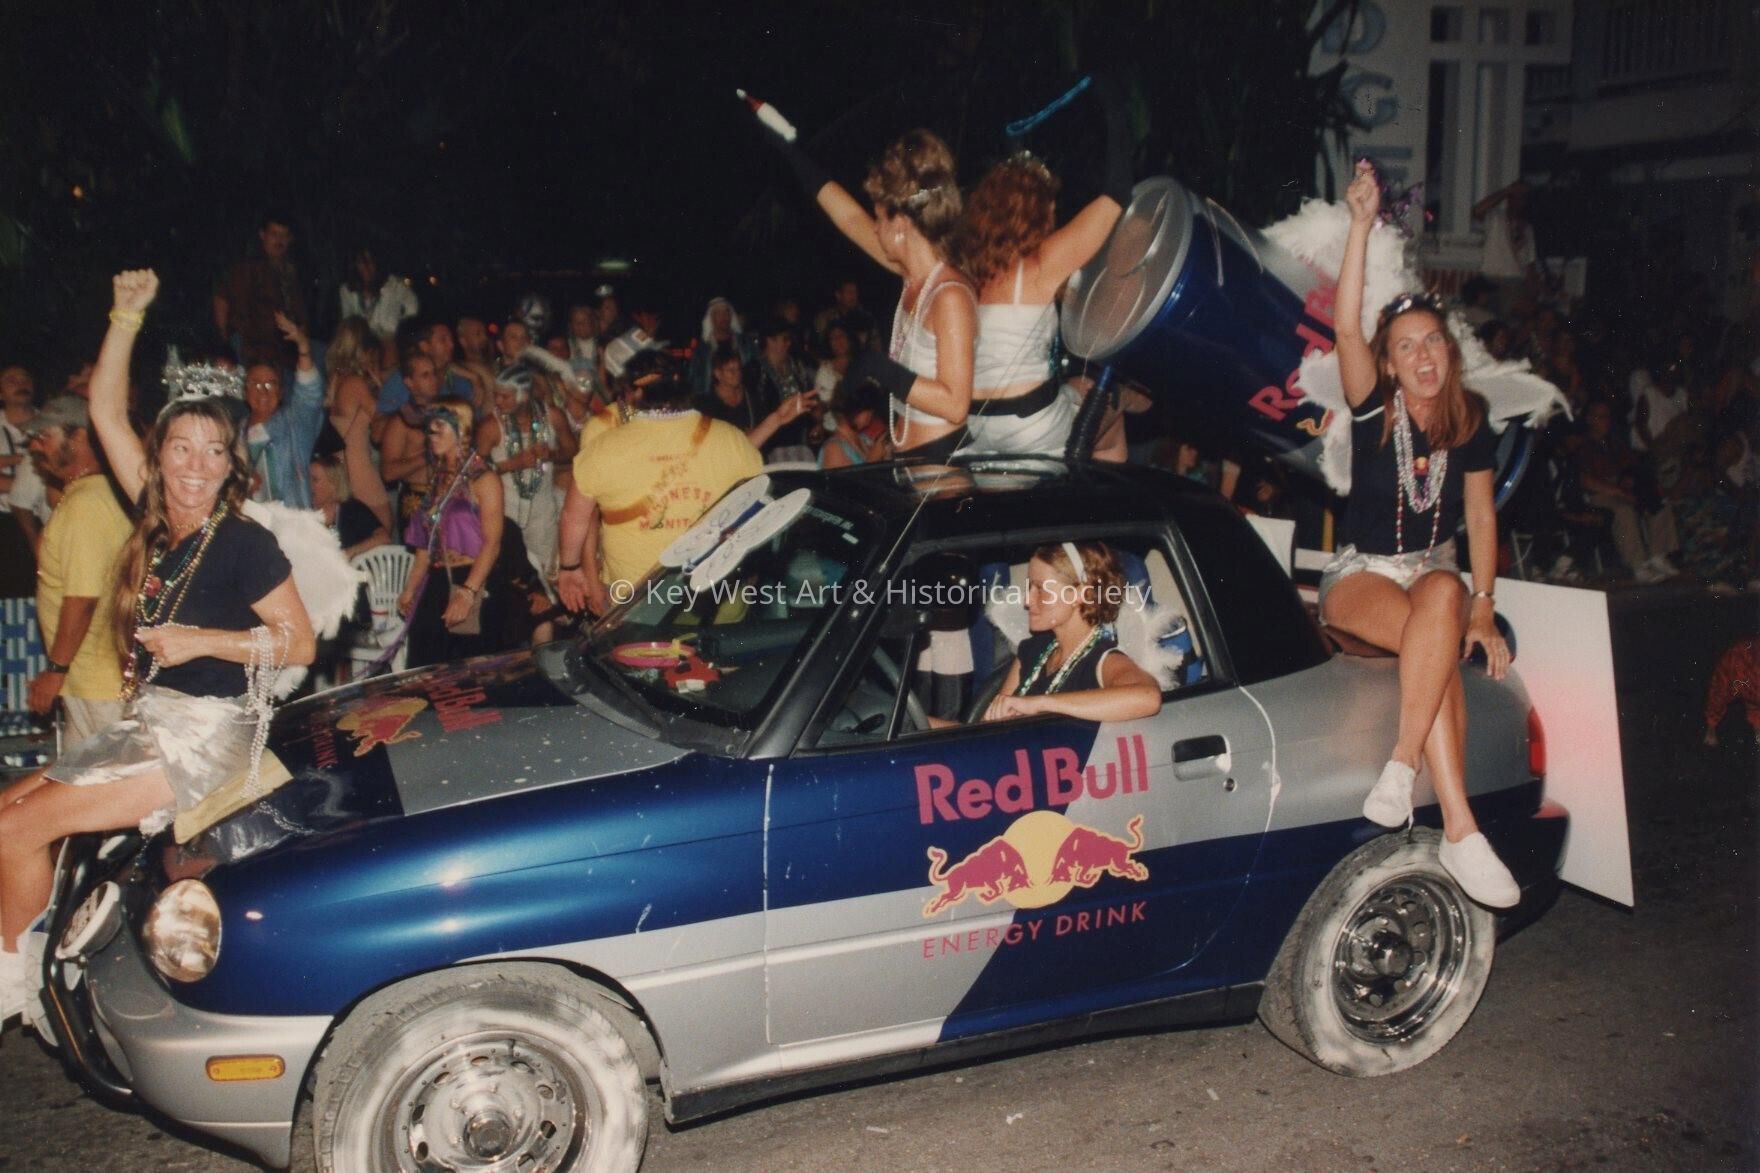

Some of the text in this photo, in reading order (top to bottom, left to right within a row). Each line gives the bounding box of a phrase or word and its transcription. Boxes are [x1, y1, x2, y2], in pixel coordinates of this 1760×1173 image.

[914, 734, 1149, 825] Red Bull
[923, 901, 1147, 960] ENERGY DRINK
